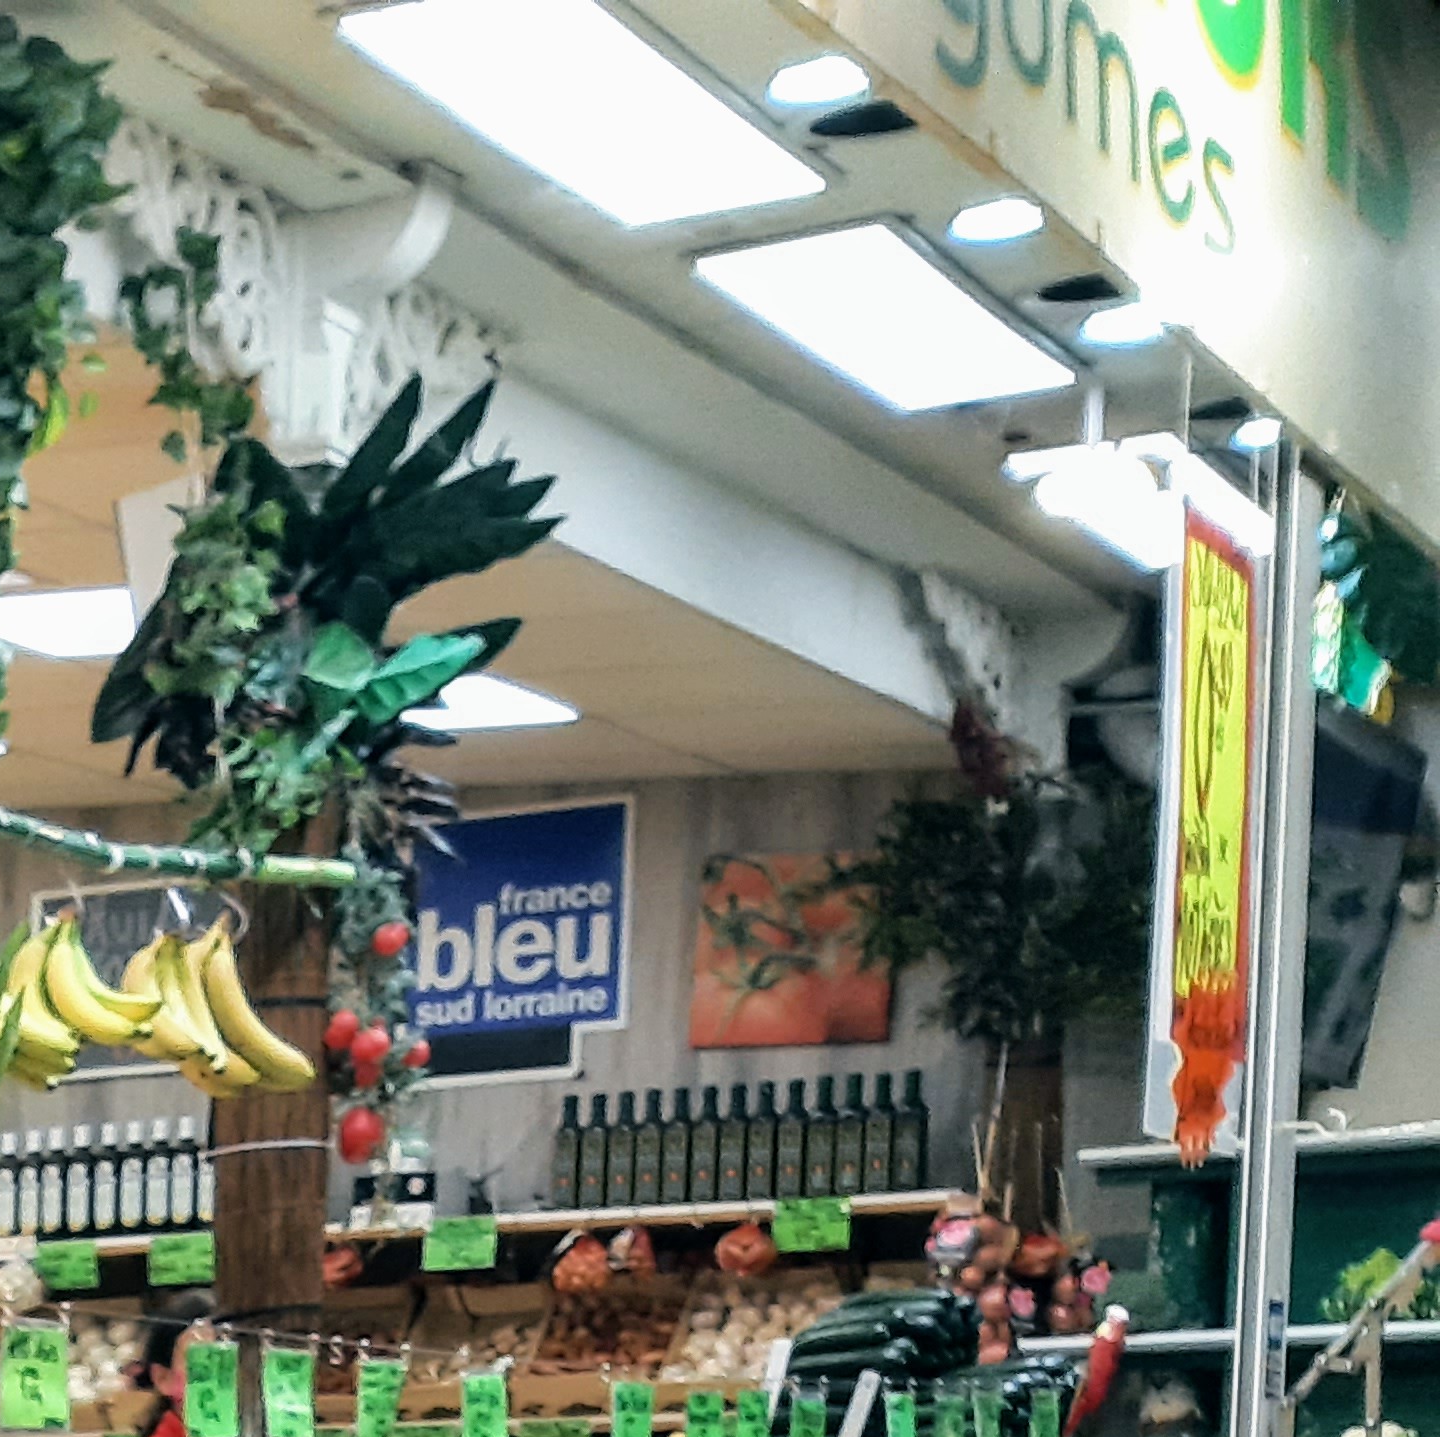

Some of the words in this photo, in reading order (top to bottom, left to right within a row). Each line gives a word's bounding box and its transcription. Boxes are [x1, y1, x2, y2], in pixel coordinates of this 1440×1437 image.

[498, 882, 612, 914] france
[418, 905, 611, 991] bleu
[415, 995, 474, 1026] sud
[483, 986, 608, 1020] lorraine
